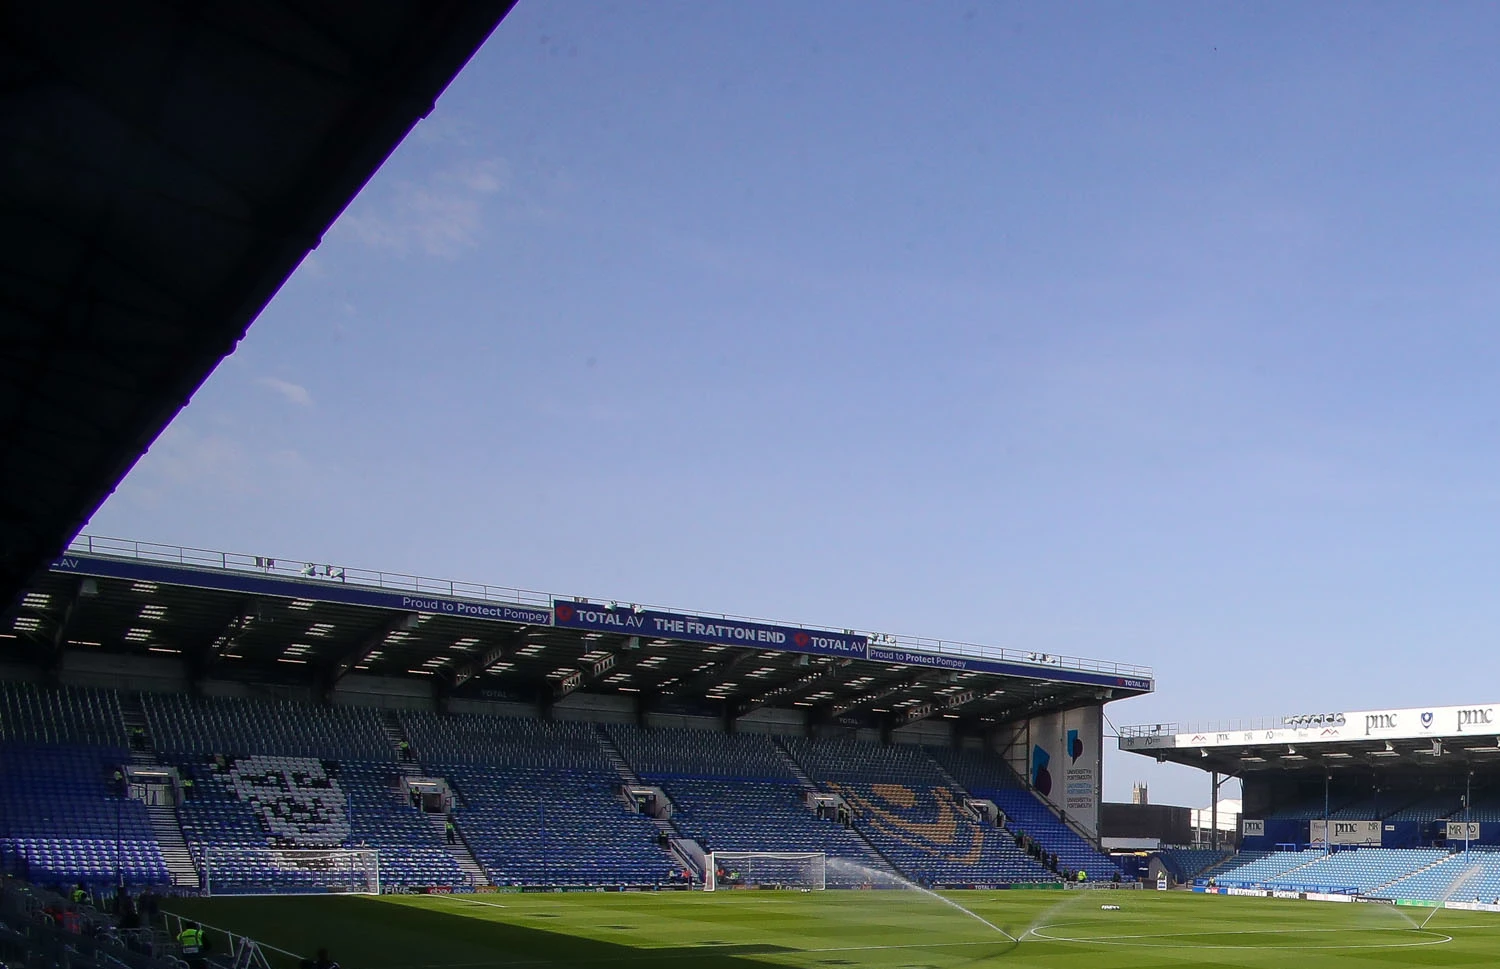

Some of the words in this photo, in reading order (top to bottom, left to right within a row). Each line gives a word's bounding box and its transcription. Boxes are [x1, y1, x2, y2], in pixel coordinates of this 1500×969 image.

[403, 597, 438, 609] Proud
[442, 602, 454, 611] to
[458, 603, 501, 616] Protect
[504, 608, 549, 624] Pompey
[654, 618, 684, 633] THE
[687, 622, 755, 641] FRATTON
[758, 630, 786, 643] END
[871, 649, 894, 660] Proud
[906, 654, 935, 664] Protect
[937, 657, 967, 669] Pompey
[1365, 713, 1397, 735] pmc
[1457, 708, 1493, 731] pmc
[1244, 821, 1262, 833] pmc
[1335, 823, 1358, 836] pmc
